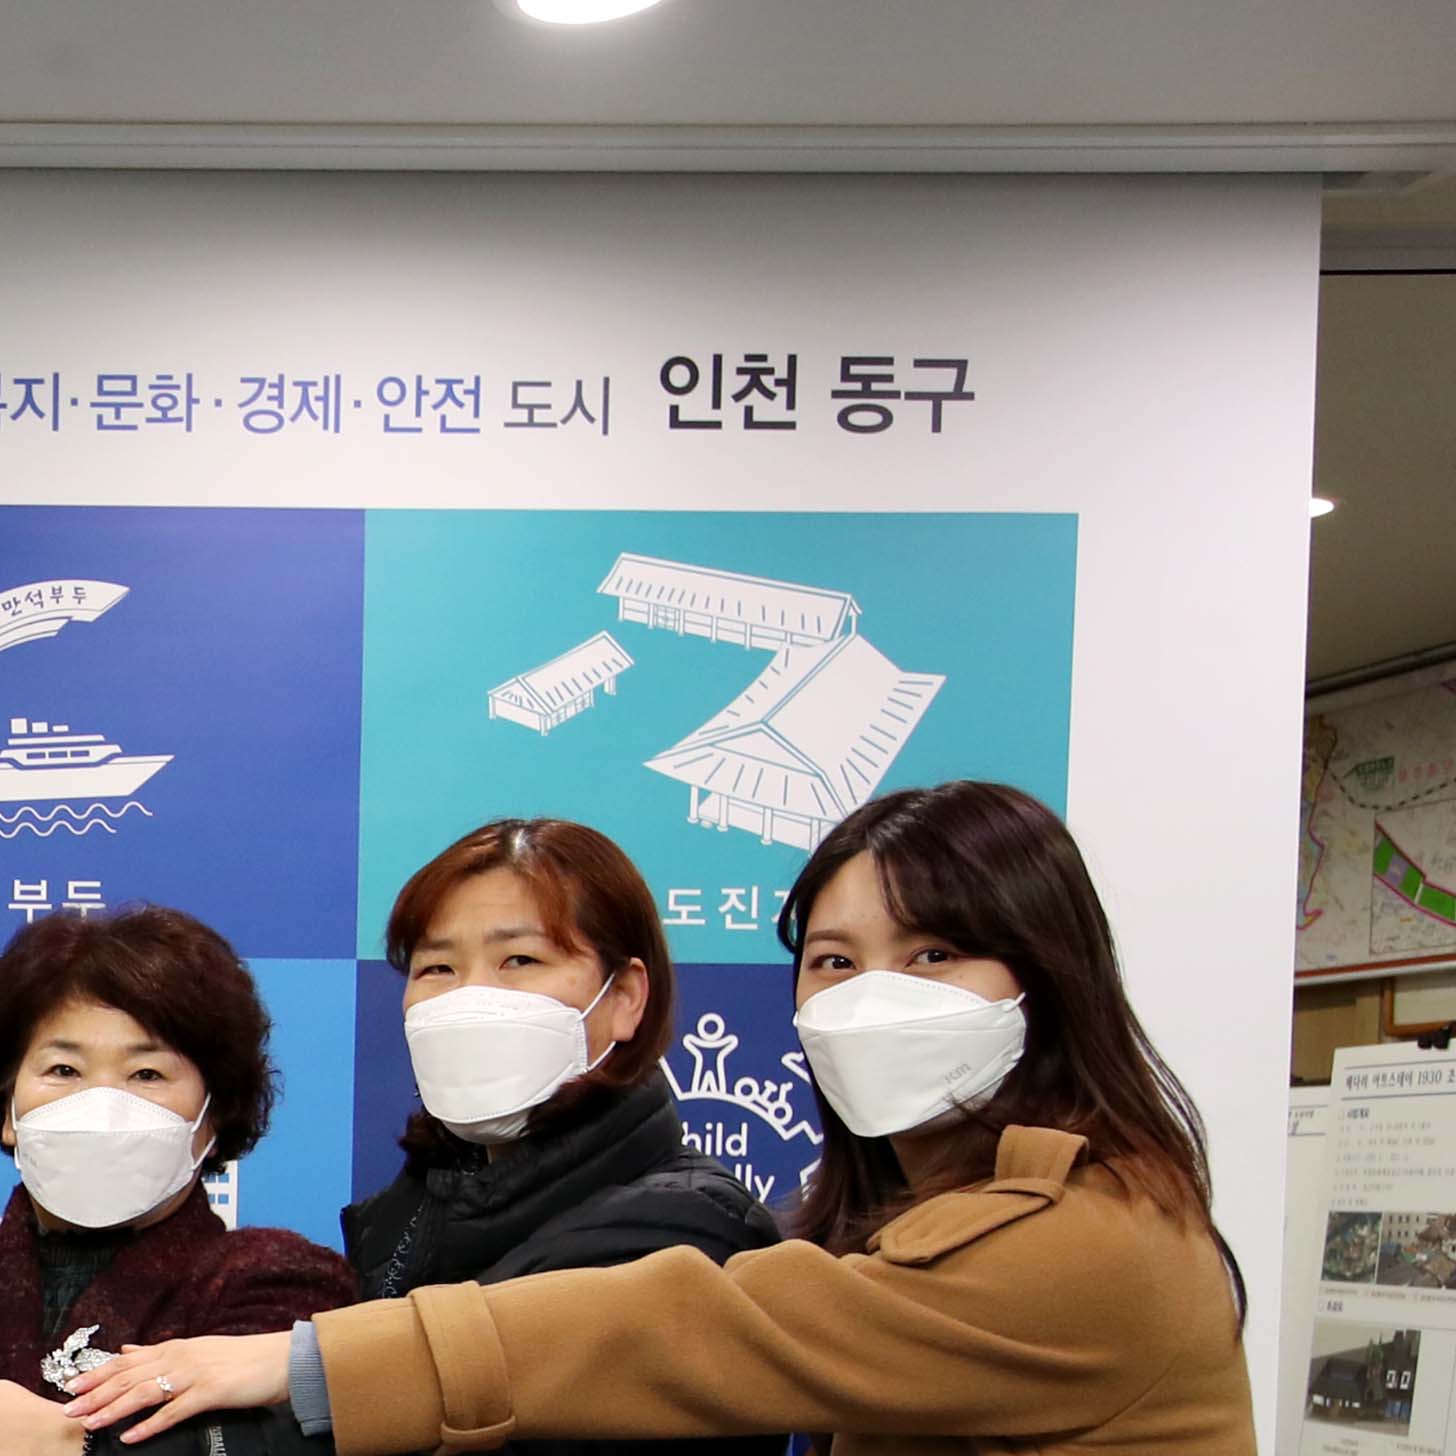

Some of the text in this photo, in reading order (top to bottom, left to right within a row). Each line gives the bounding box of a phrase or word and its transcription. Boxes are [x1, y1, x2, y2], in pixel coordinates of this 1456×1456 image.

[501, 375, 614, 437] 도시
[657, 352, 799, 434] 인천
[829, 356, 978, 436] 동구
[0, 584, 87, 618] 만석부두
[662, 885, 791, 931] 도진
[1417, 1069, 1443, 1086] 1930
[681, 1121, 749, 1157] hild
